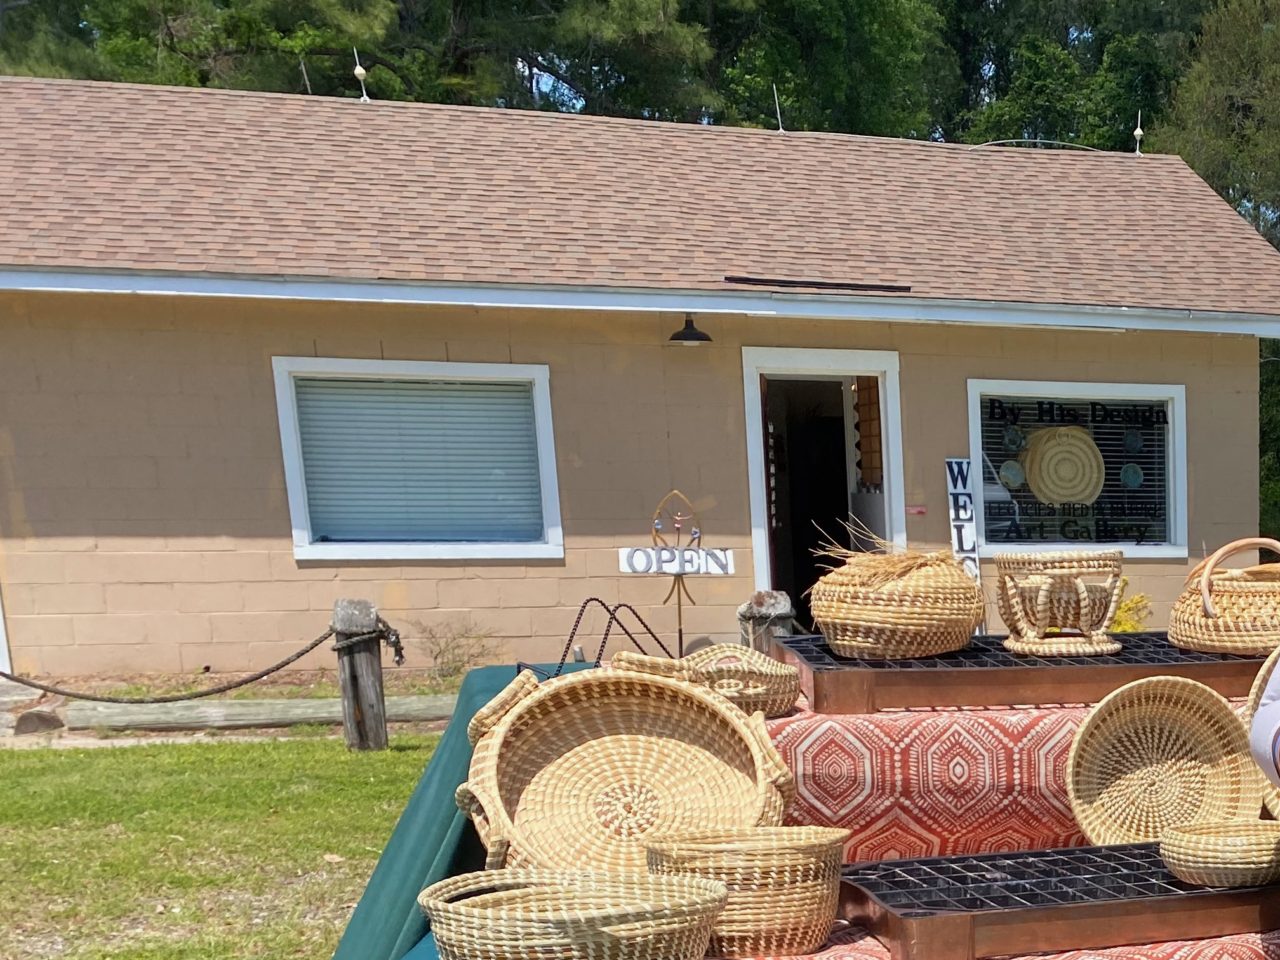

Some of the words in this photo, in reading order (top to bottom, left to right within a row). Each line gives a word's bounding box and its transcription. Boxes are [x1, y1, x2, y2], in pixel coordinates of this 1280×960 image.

[989, 399, 1022, 425] By
[1037, 401, 1078, 423] His
[1091, 402, 1169, 429] Design
[1005, 519, 1049, 540] Art
[626, 547, 730, 575] OPEN
